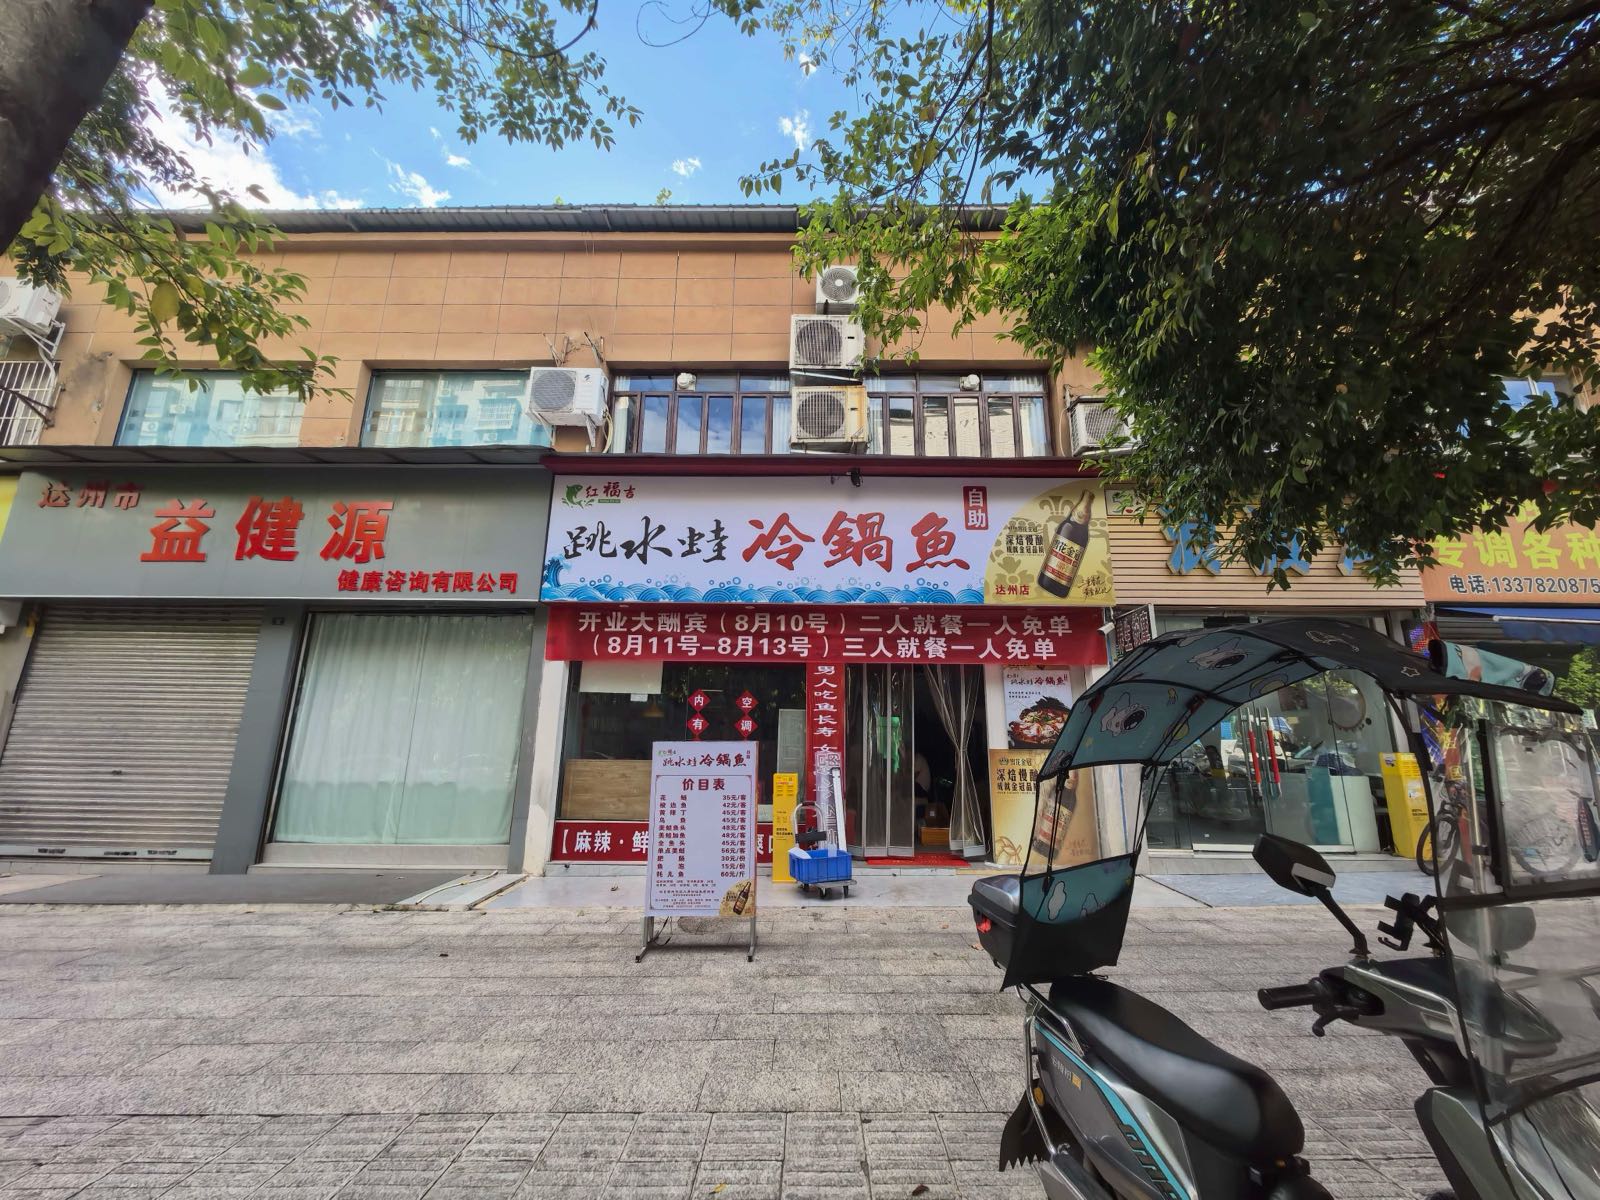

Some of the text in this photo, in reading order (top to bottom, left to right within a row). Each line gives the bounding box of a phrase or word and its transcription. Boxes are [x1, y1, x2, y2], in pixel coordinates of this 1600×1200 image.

[38, 481, 142, 510] 达州市
[967, 489, 986, 527] 自助
[140, 496, 395, 564] 益健源
[563, 516, 729, 565] 跳水蛙
[1429, 530, 1600, 569] 专调各种
[337, 570, 519, 594] 健康咨询有限公司
[995, 584, 1030, 595] 达州店
[692, 694, 704, 730] 内有
[740, 697, 752, 731] 空调
[682, 778, 725, 791] 价目表
